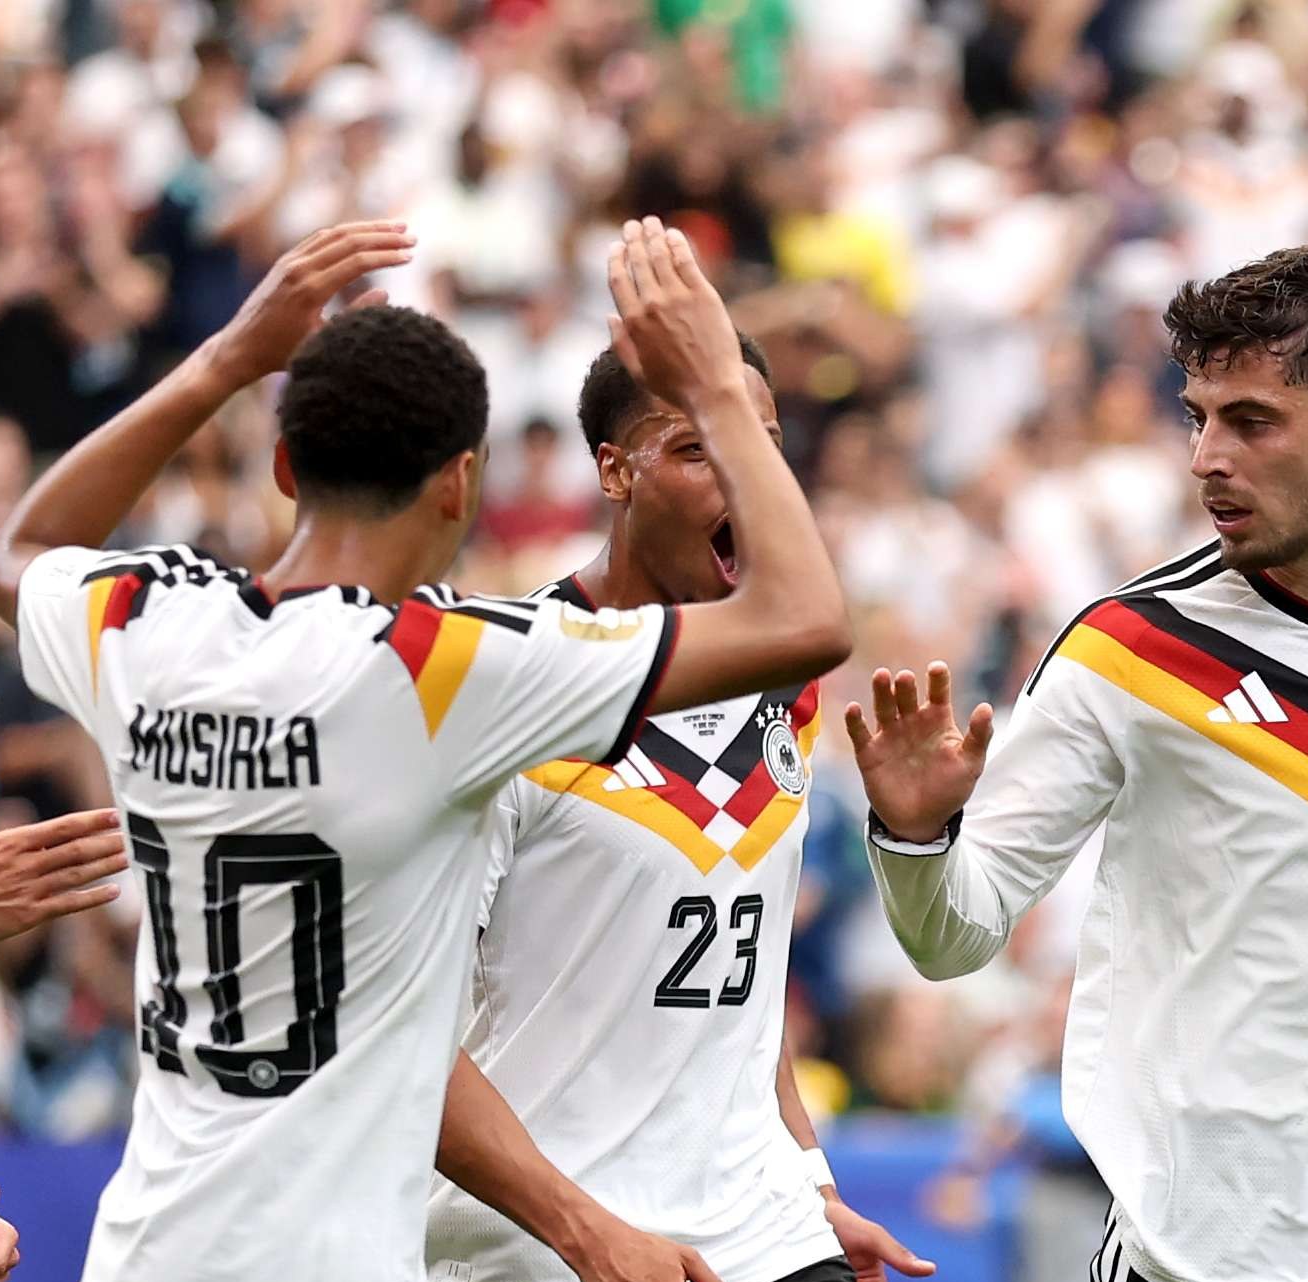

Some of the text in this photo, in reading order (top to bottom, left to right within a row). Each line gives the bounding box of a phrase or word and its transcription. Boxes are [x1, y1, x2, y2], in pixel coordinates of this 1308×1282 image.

[129, 703, 322, 790] MUSIALA
[127, 811, 345, 1098] 10
[653, 893, 764, 1009] 23
